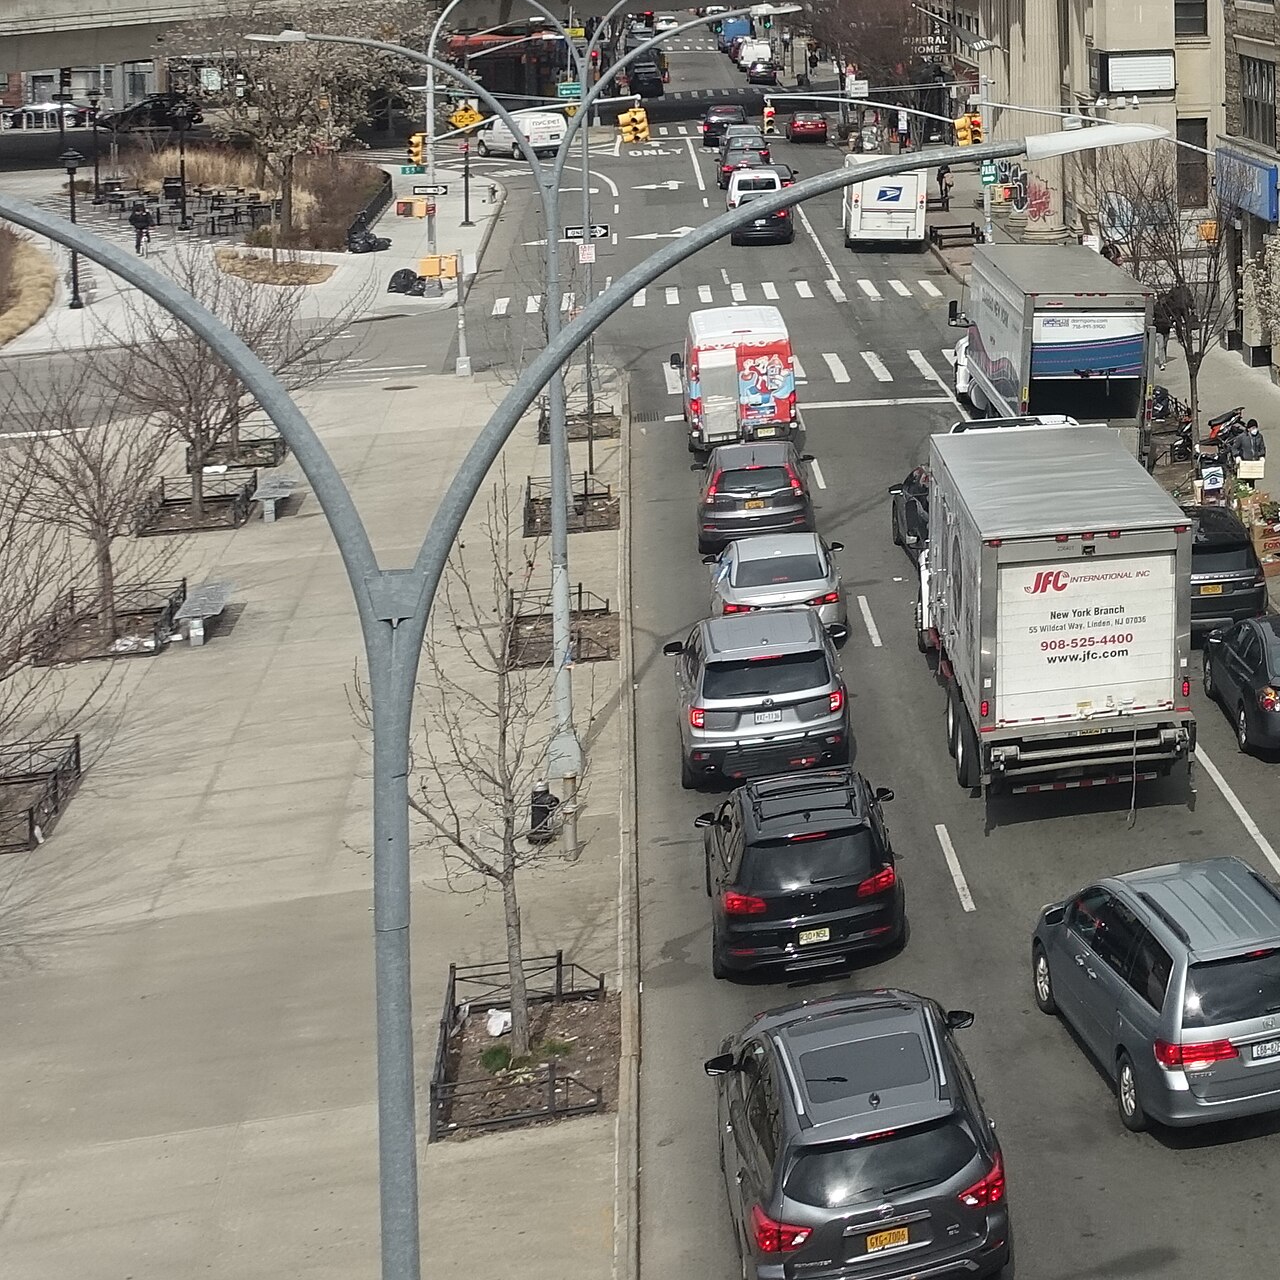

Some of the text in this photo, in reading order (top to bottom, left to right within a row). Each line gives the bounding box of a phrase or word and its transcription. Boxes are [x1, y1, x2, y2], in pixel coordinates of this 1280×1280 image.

[628, 147, 683, 157] ONLY
[981, 165, 996, 175] PARK
[1024, 570, 1070, 594] JFC
[1070, 573, 1133, 583] INTERNATIONAL
[1050, 605, 1125, 620] New York Branch
[1040, 624, 1066, 632] Wildcat
[1040, 633, 1133, 651] 908-525-4400
[1047, 648, 1129, 664] www.jfc.com
